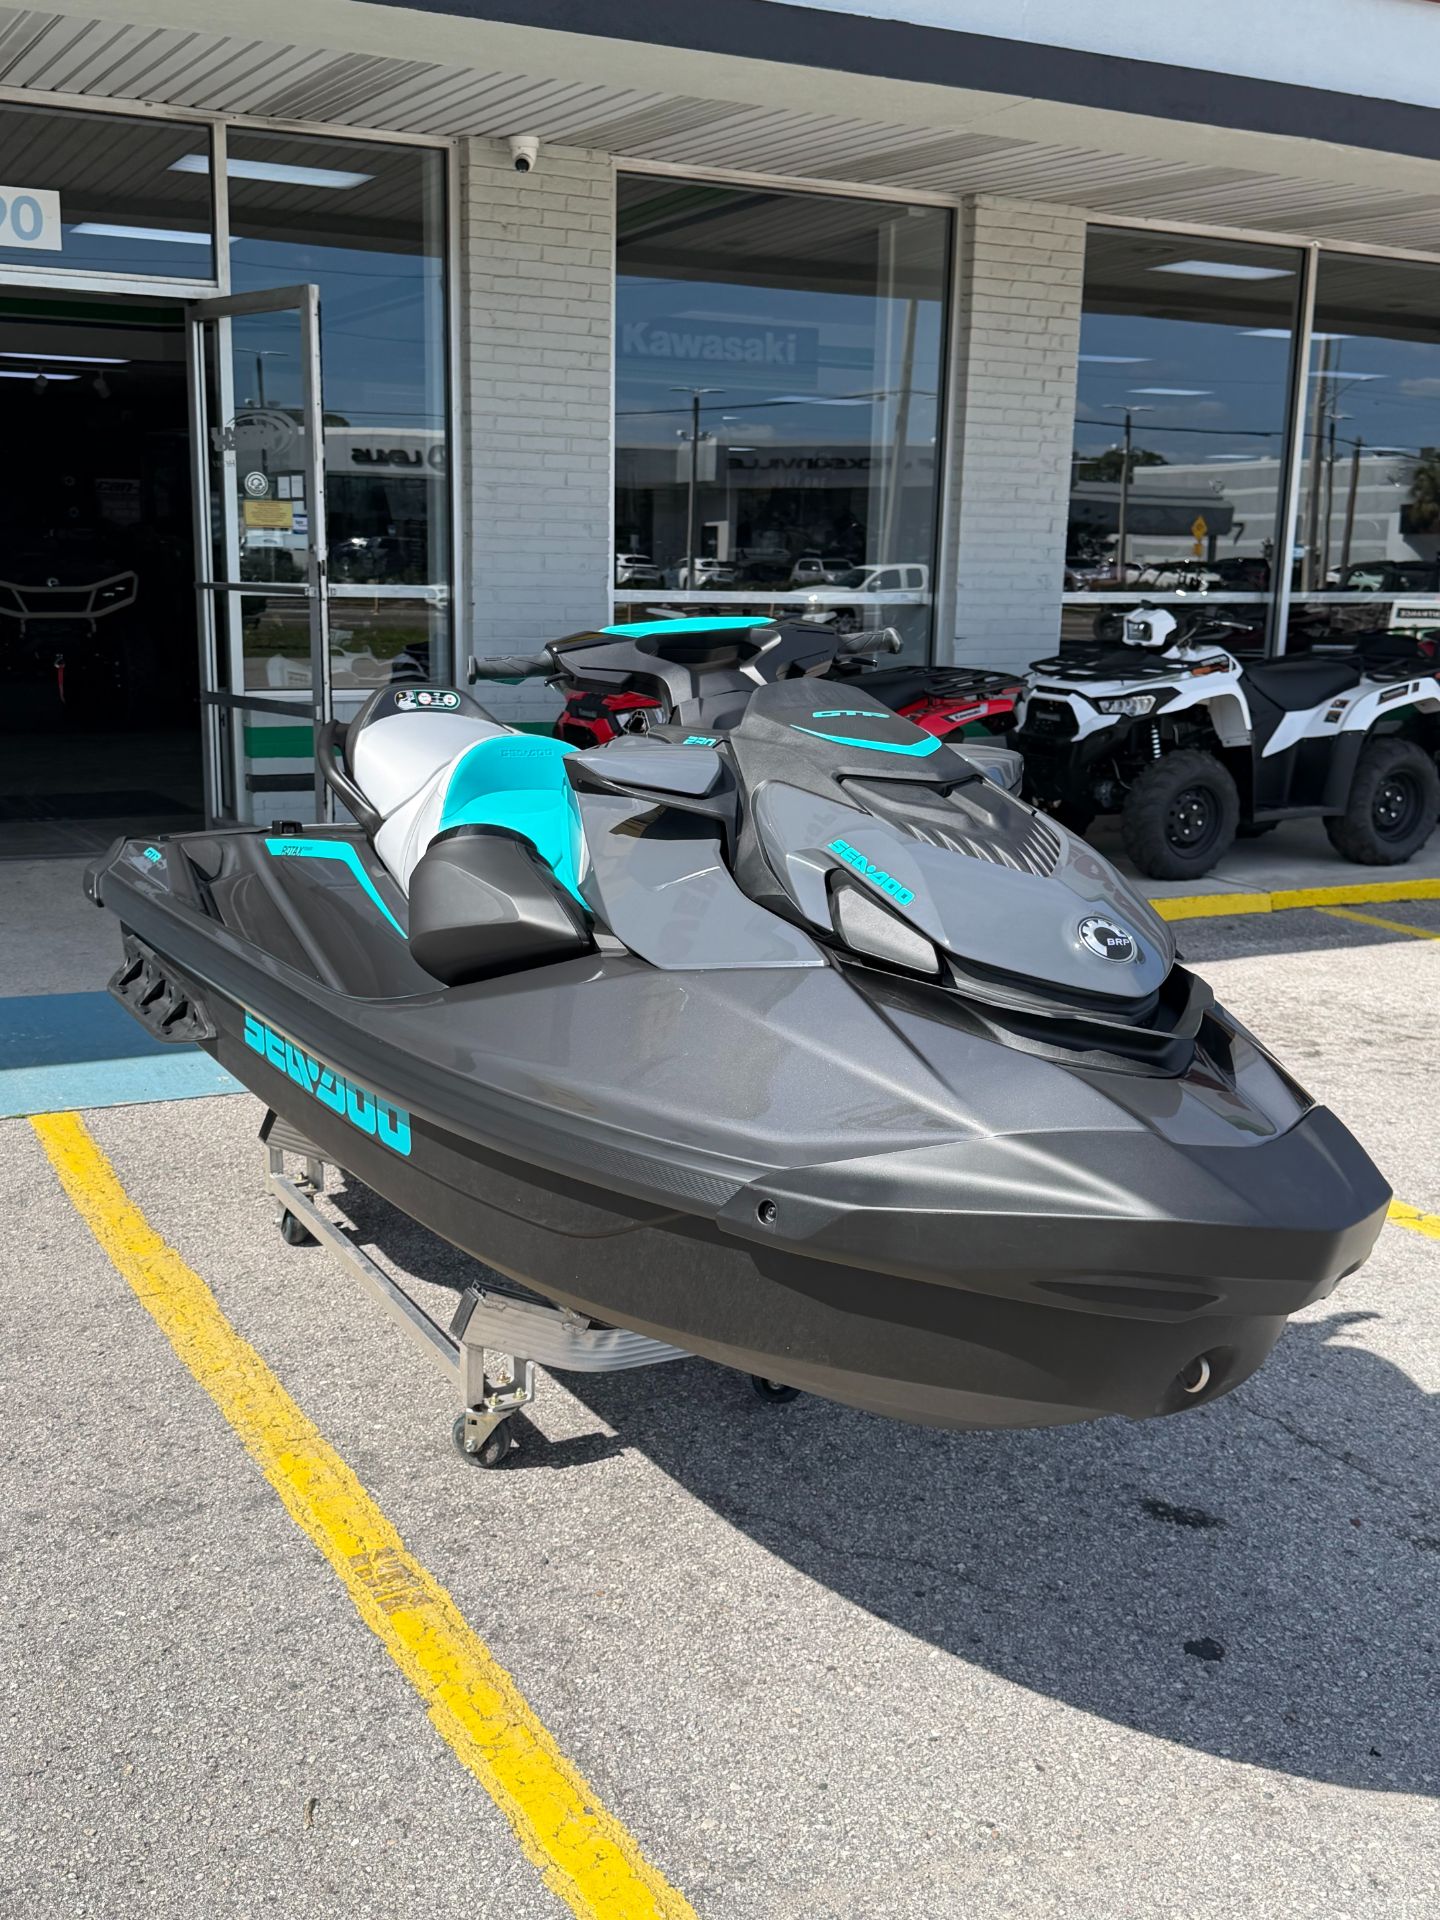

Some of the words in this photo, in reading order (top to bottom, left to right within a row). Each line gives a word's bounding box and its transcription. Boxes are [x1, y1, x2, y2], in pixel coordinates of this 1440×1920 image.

[0, 195, 43, 241] 0
[622, 321, 797, 366] Kawasaki
[814, 708, 890, 719] GTR
[683, 735, 717, 747] 230
[1106, 937, 1131, 946] BRP
